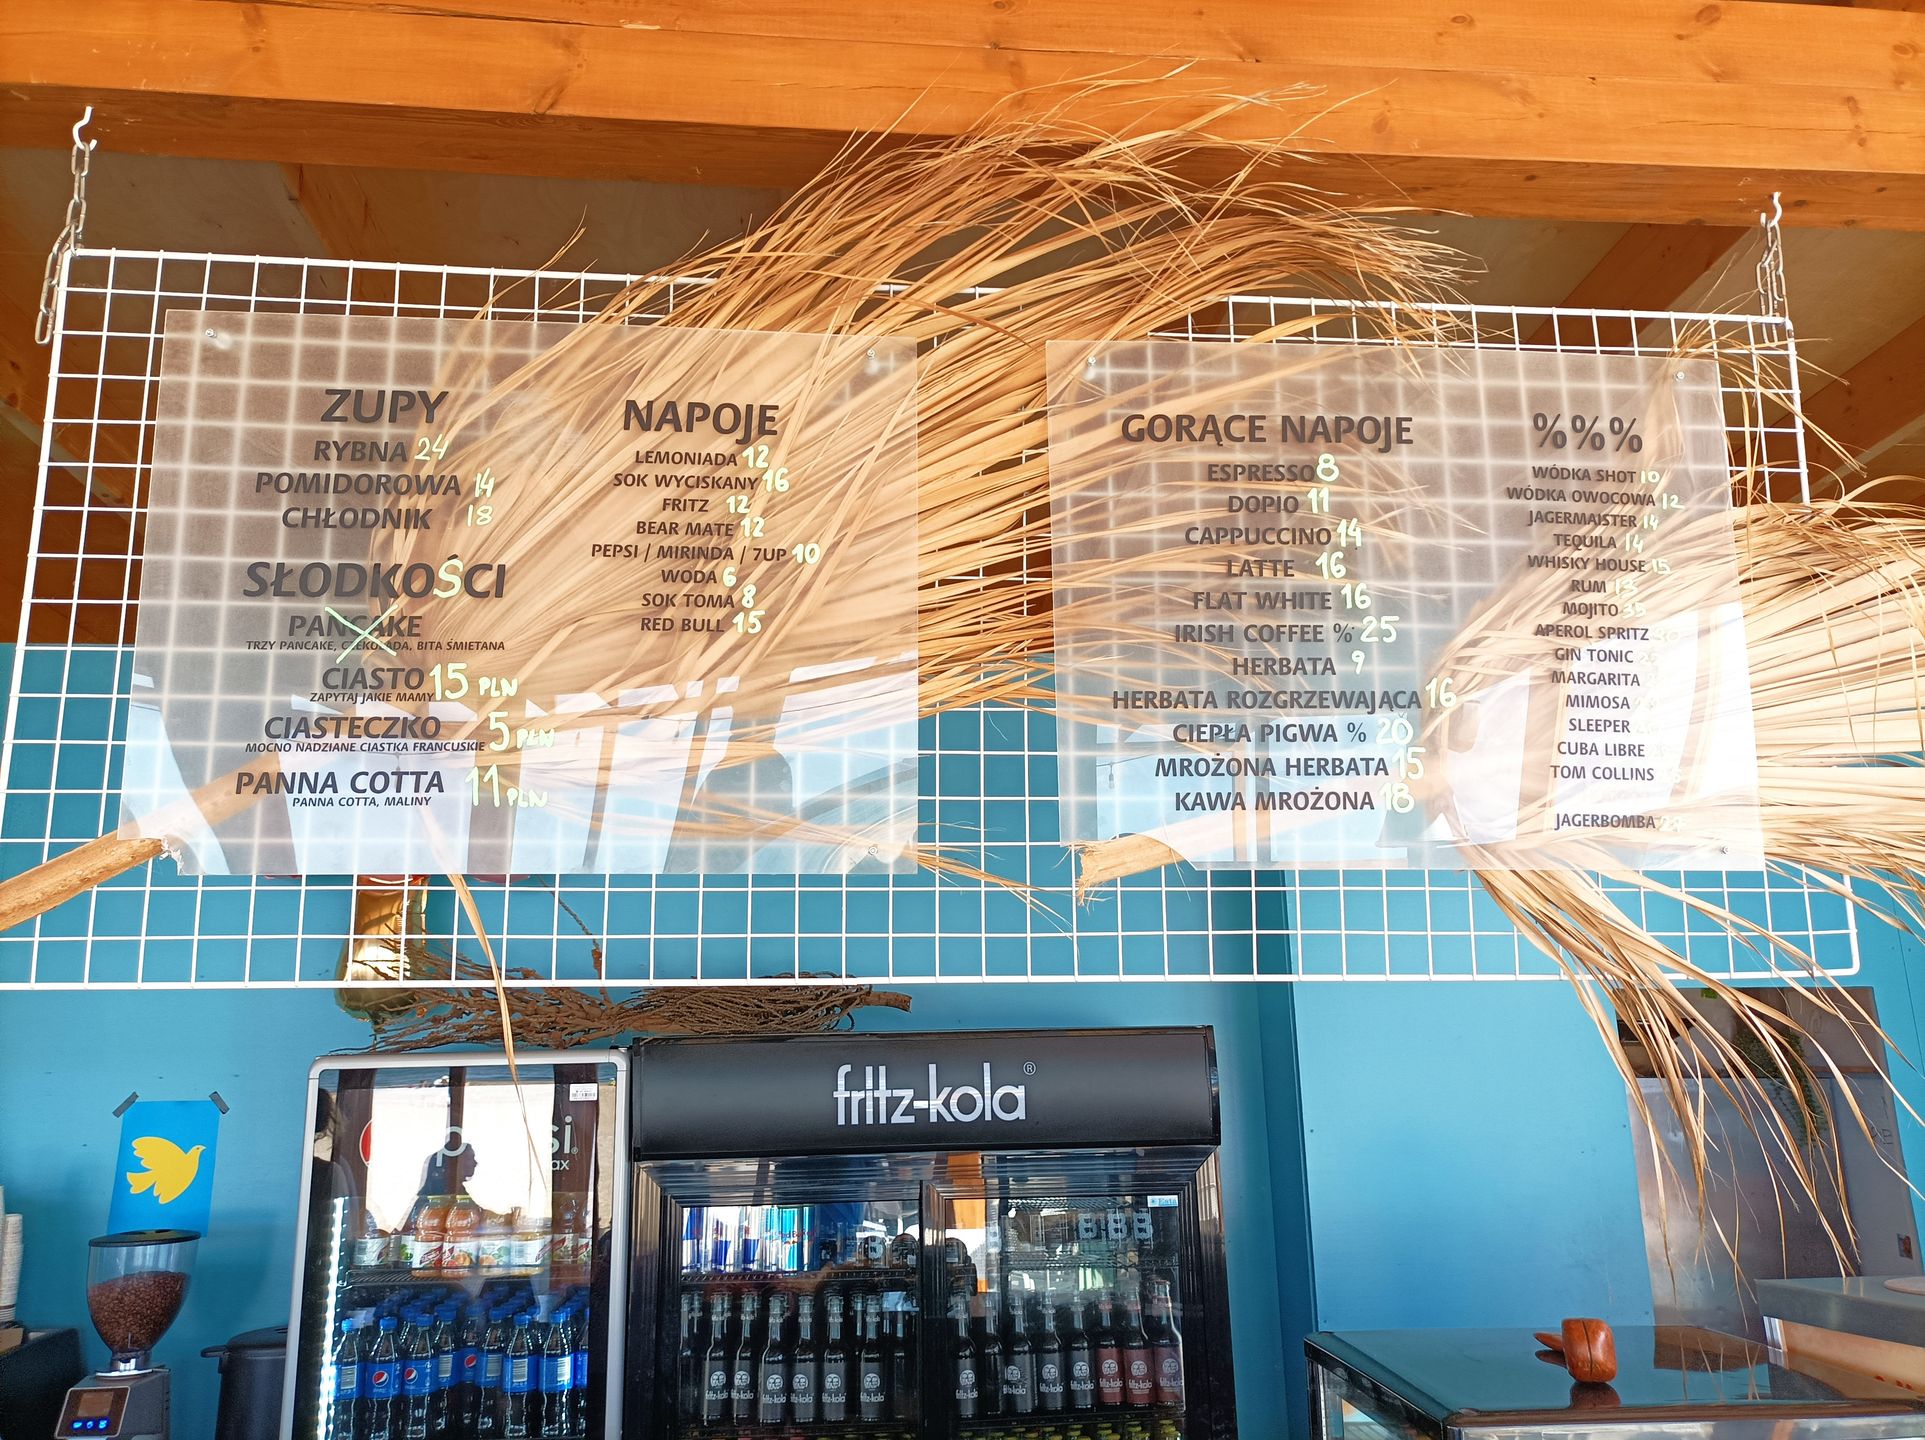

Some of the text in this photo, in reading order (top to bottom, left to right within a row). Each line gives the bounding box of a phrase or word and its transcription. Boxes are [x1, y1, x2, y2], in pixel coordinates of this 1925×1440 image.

[320, 388, 449, 424] ZUPY
[623, 399, 780, 445] NAPOJE
[1121, 414, 1414, 453] GORĄCE NAPOJE
[1532, 412, 1643, 454] %%%
[313, 437, 449, 462] RYBNA 24
[635, 444, 769, 469] LEMONIADA 12
[613, 467, 790, 493] SOK WYCISKANY 16
[1207, 453, 1340, 482] ESPRESSO 8
[1532, 464, 1661, 484] WÓDKA SHOT 10
[255, 468, 495, 499] POMIDOROWA 14
[662, 495, 750, 514] FRITZ 12
[1228, 487, 1330, 514] DOPIO 11
[1506, 485, 1685, 510] WÓDKA OWOCOWA 12
[282, 504, 493, 530] CHŁODNIK 18
[636, 516, 765, 538] BEAR MATE 12
[1527, 510, 1659, 531] JAGERMAISTER 14
[1185, 518, 1362, 548] CAPPUCCINO 14
[1553, 532, 1644, 554] TEQUILA 14
[591, 543, 638, 559] PEPSI
[656, 545, 734, 561] MIRINDA
[753, 548, 787, 562] 7UP
[792, 543, 821, 565] 10
[1227, 551, 1347, 580] LATTE 16
[1528, 555, 1590, 570] WHISKY
[1595, 558, 1647, 573] HOUSE
[243, 553, 506, 600] SŁODKOŚCI
[661, 566, 737, 587] WODA 6
[1571, 579, 1607, 594] RUM
[642, 584, 756, 609] SOK TOMA 8
[1193, 582, 1372, 610] FLAT WHITE 16
[641, 610, 766, 634] RED BULL 15
[1563, 603, 1619, 620] MOJITO
[1175, 624, 1234, 643] IRISH
[1244, 624, 1324, 643] COFFEE
[1360, 615, 1400, 643] 25
[1535, 624, 1592, 640] APEROL
[1598, 626, 1650, 641] SPRITZ
[246, 640, 276, 651] TRZY
[279, 640, 337, 652] PANCAKE,
[417, 640, 442, 651] BITA
[446, 638, 506, 651] ŚMIETANA
[1555, 648, 1581, 662] GIN
[1586, 649, 1634, 663] TONIC
[1232, 650, 1366, 676] HERBATA 9
[322, 662, 519, 701] CIASTO 15 PLN
[1551, 671, 1640, 686] MARGARITA
[310, 692, 433, 704] ZAPYTAJ JAKIE MAMY
[1112, 678, 1457, 714] HERBATA ROZGRZEWAJĄCA 16
[1565, 695, 1631, 709] MIMOSA
[264, 717, 441, 739] CIASTECZKO
[489, 712, 510, 751] 5
[1173, 717, 1414, 745] CIEPŁA PIGWA % 20
[1569, 718, 1631, 733] SLEEPER
[245, 741, 485, 752] MOCNO NADZIANE CIASTKA FRANCUSKIE
[1557, 741, 1599, 756] CUBA
[1604, 743, 1645, 757] LIBRE
[1155, 747, 1426, 779] MROŻONA HERBATA 15
[1550, 765, 1586, 779] TOM
[1592, 766, 1655, 781] COLLINS
[235, 771, 339, 794] PANNA
[350, 771, 445, 793] COTTA
[464, 763, 501, 807] 11
[1175, 782, 1415, 813] KAWA MROŻONA 18
[292, 796, 431, 808] PANNA COTTA, MALINY
[1554, 813, 1656, 830] JAGERBOMBA
[833, 1062, 1026, 1125] fritz-kola
